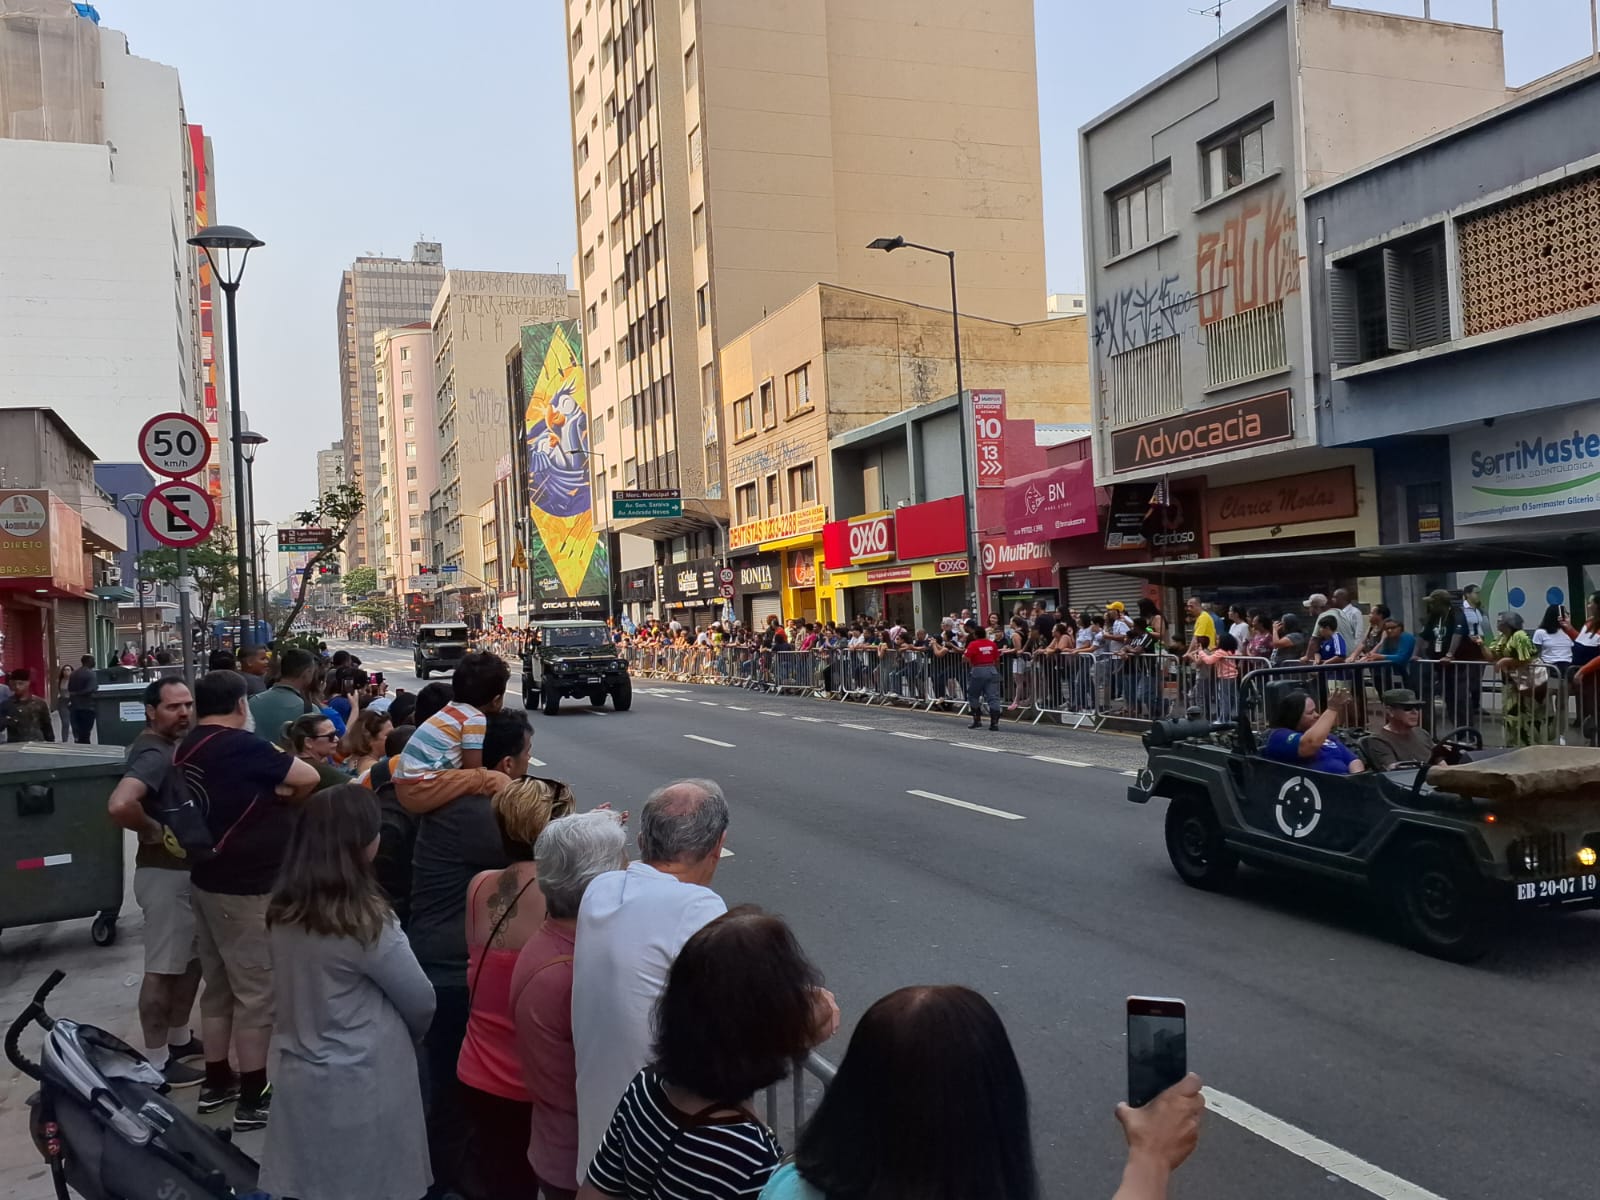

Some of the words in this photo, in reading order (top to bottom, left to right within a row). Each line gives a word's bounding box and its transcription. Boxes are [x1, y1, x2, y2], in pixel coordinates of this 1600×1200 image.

[977, 418, 1002, 439] 10
[1135, 409, 1261, 462] Advocacia
[154, 430, 197, 457] 50
[981, 445, 998, 460] 13
[164, 460, 188, 468] km/h
[1049, 482, 1065, 502] BN
[1220, 495, 1273, 520] Clarice
[1278, 485, 1335, 512] Modas
[166, 494, 192, 532] E
[3, 541, 42, 549] DIRETO
[730, 521, 762, 548] DENTISTAS
[850, 519, 888, 558] OXXO
[1153, 530, 1195, 546] Cardoso
[998, 538, 1052, 562] MultiPark
[741, 564, 772, 585] BONITA
[938, 560, 968, 573] OXXO
[1517, 882, 1536, 900] EB
[1539, 877, 1575, 897] 20-07
[1581, 874, 1596, 891] 19
